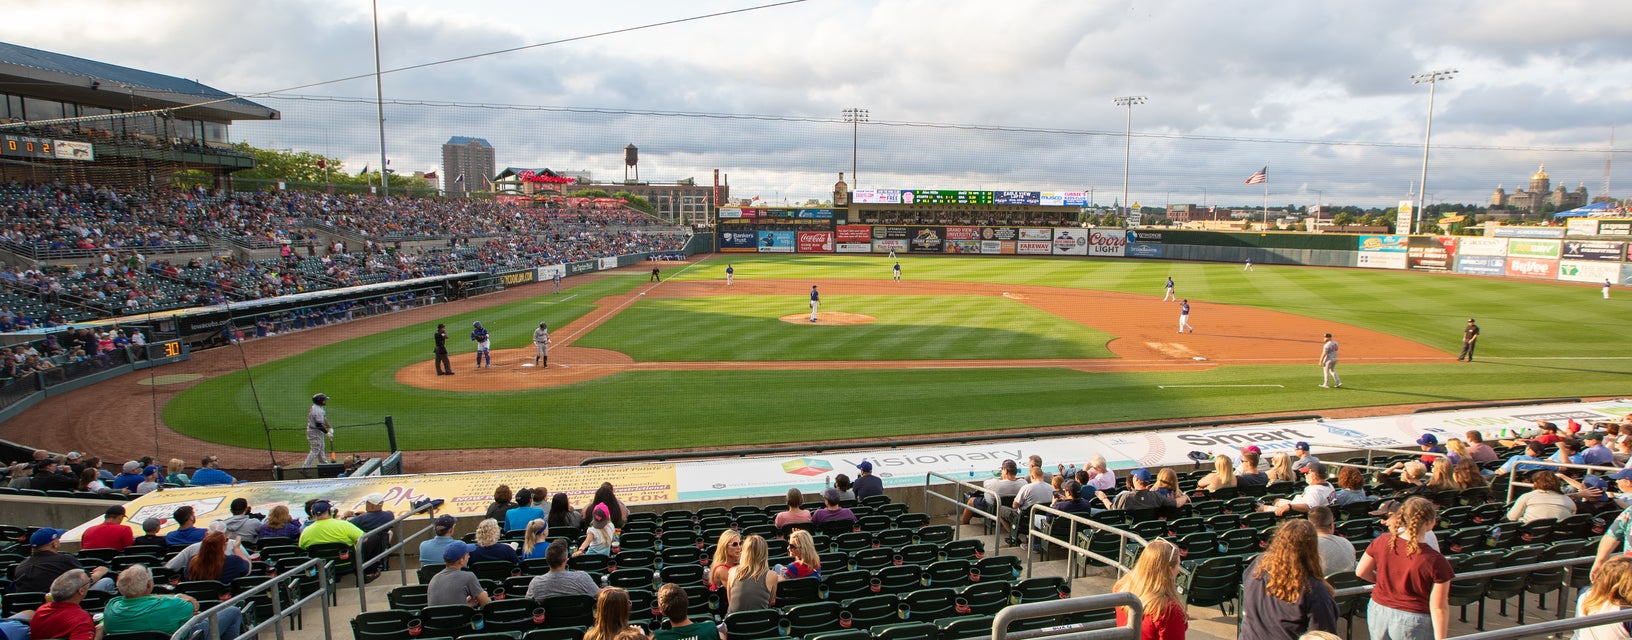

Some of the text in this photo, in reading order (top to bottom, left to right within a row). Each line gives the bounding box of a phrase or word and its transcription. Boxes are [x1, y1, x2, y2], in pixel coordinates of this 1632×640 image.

[8, 140, 17, 151] 0
[26, 142, 34, 152] 0
[42, 143, 50, 153] 2
[518, 170, 576, 183] Budweiser
[801, 234, 826, 242] Coca-Cola
[1090, 232, 1126, 246] Coors
[164, 342, 179, 357] 30
[1177, 428, 1314, 446] Smart
[842, 450, 1023, 468] Visionary
